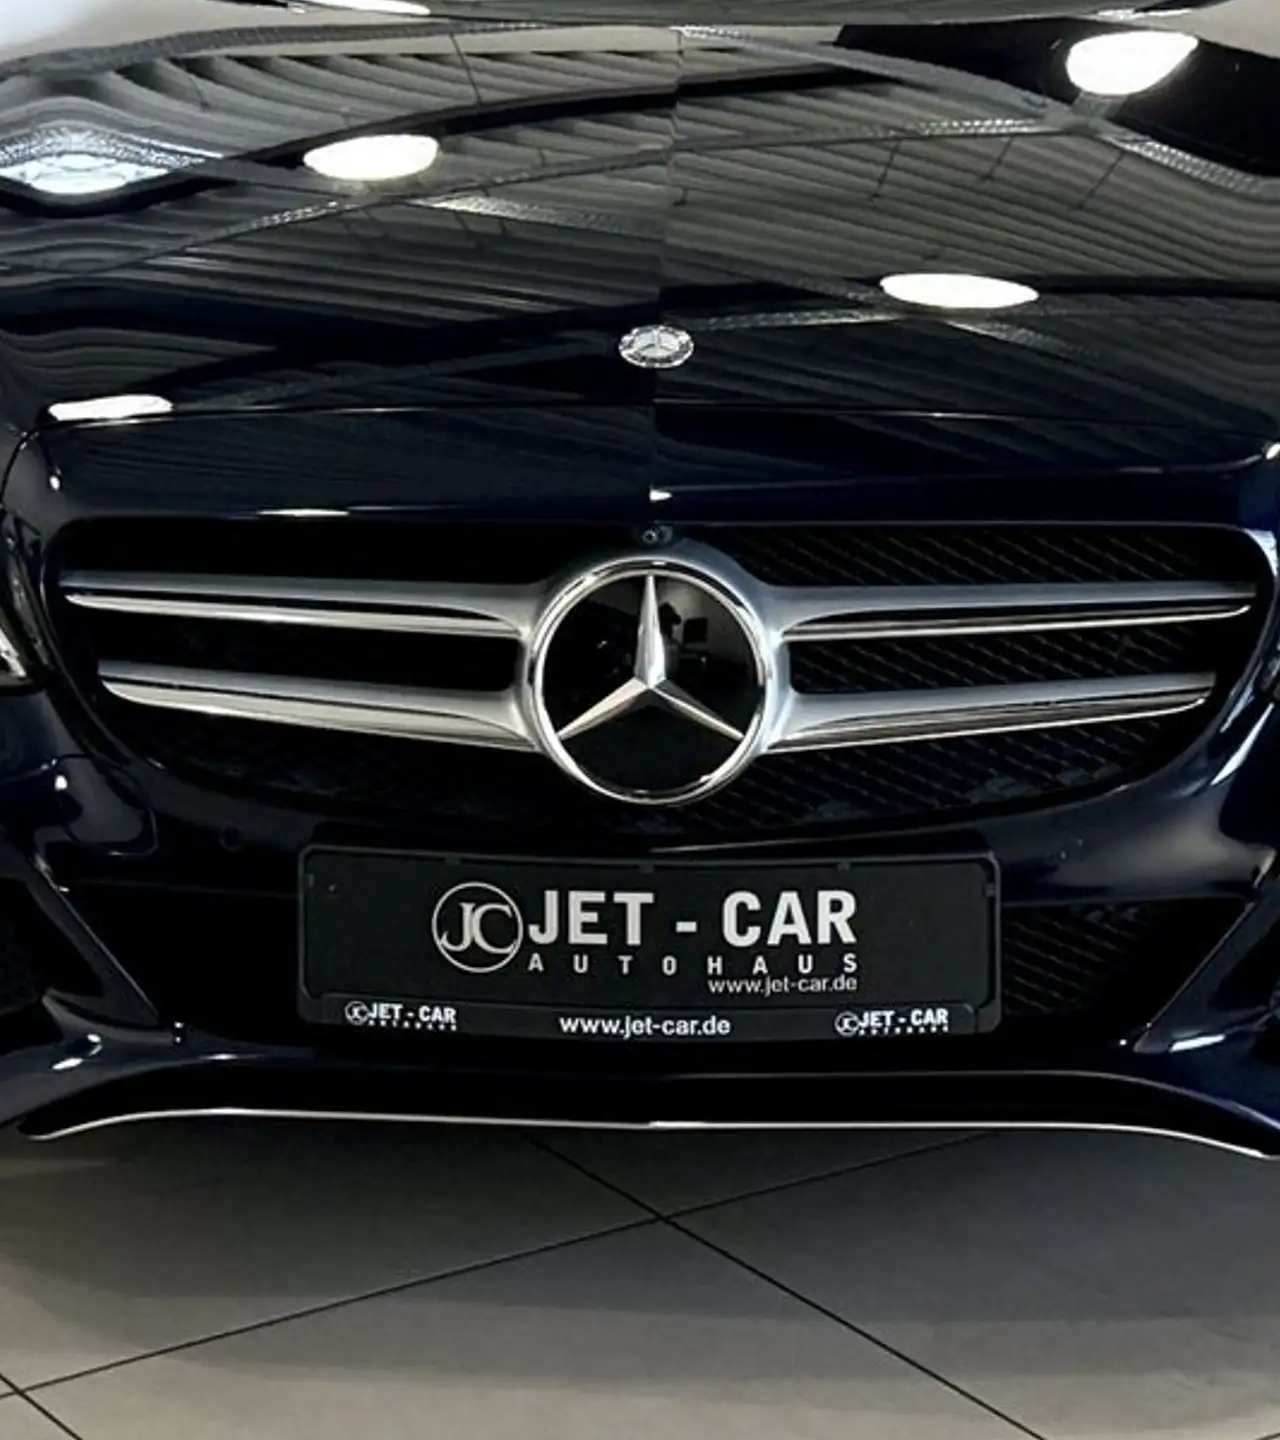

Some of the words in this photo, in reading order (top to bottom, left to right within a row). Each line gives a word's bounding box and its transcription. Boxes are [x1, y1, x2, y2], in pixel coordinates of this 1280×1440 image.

[527, 889, 655, 947] JET
[675, 920, 698, 934] -
[722, 889, 858, 948] CAR
[526, 952, 859, 977] AUTOHAUS
[707, 973, 858, 998] www.jet-car.de
[368, 1001, 404, 1020] JET
[418, 1005, 458, 1025] CAR
[859, 1009, 896, 1029] JET
[910, 1007, 949, 1027] CAR
[558, 1014, 732, 1041] www.jet-car.de
